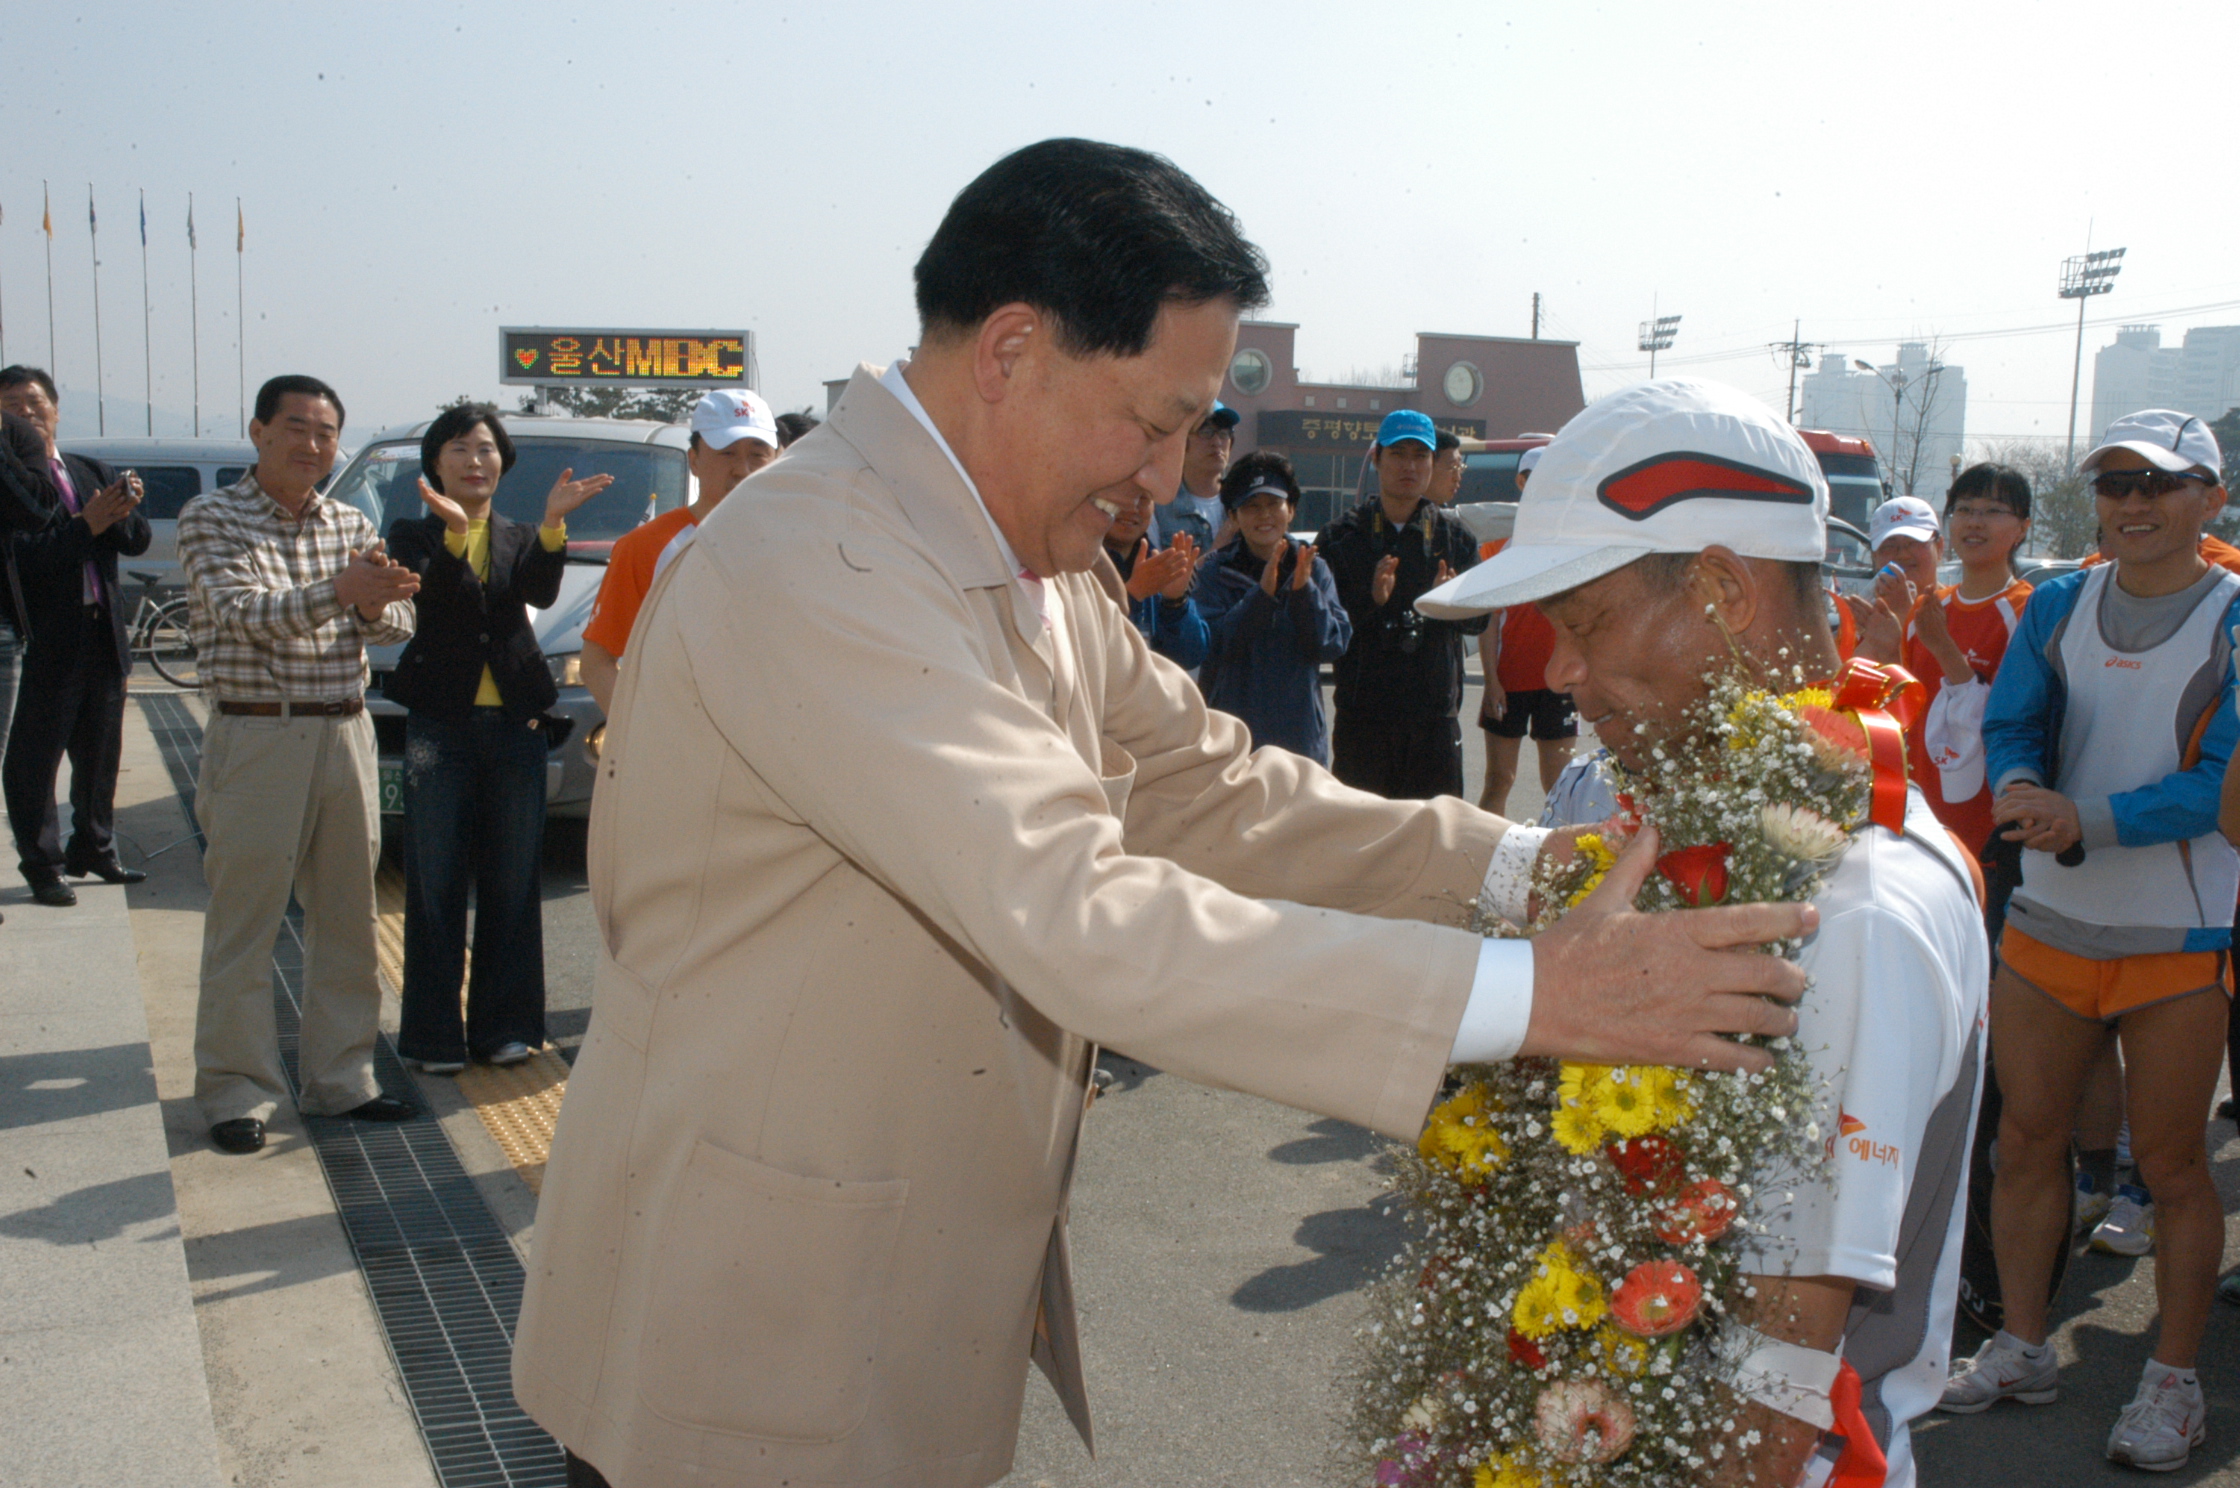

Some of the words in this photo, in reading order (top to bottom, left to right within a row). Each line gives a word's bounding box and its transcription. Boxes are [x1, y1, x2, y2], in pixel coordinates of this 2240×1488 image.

[548, 336, 743, 378] 울산MBC
[734, 407, 750, 417] SK
[1890, 514, 1903, 523] SK
[1934, 755, 1948, 766] SK
[1849, 1137, 1900, 1170] 에너지
